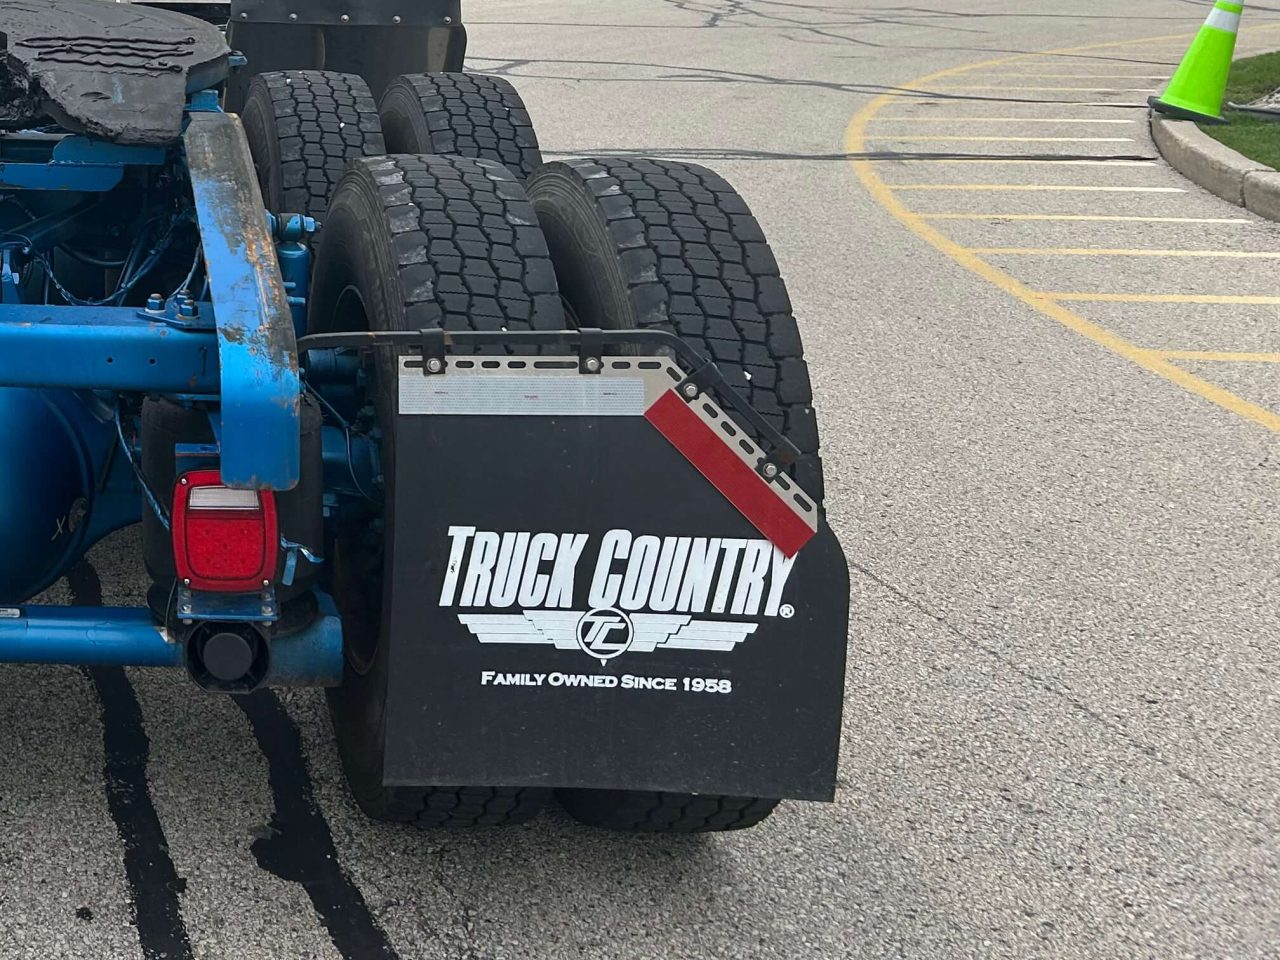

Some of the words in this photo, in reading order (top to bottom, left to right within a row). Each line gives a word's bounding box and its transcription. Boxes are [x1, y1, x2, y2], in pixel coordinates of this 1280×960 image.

[438, 525, 589, 609] TRUCK
[587, 529, 799, 617] COUNTRY
[480, 670, 547, 686] FAMILY
[547, 671, 619, 689] OWNED
[620, 673, 678, 691] SINCE
[682, 676, 733, 694] 1958
